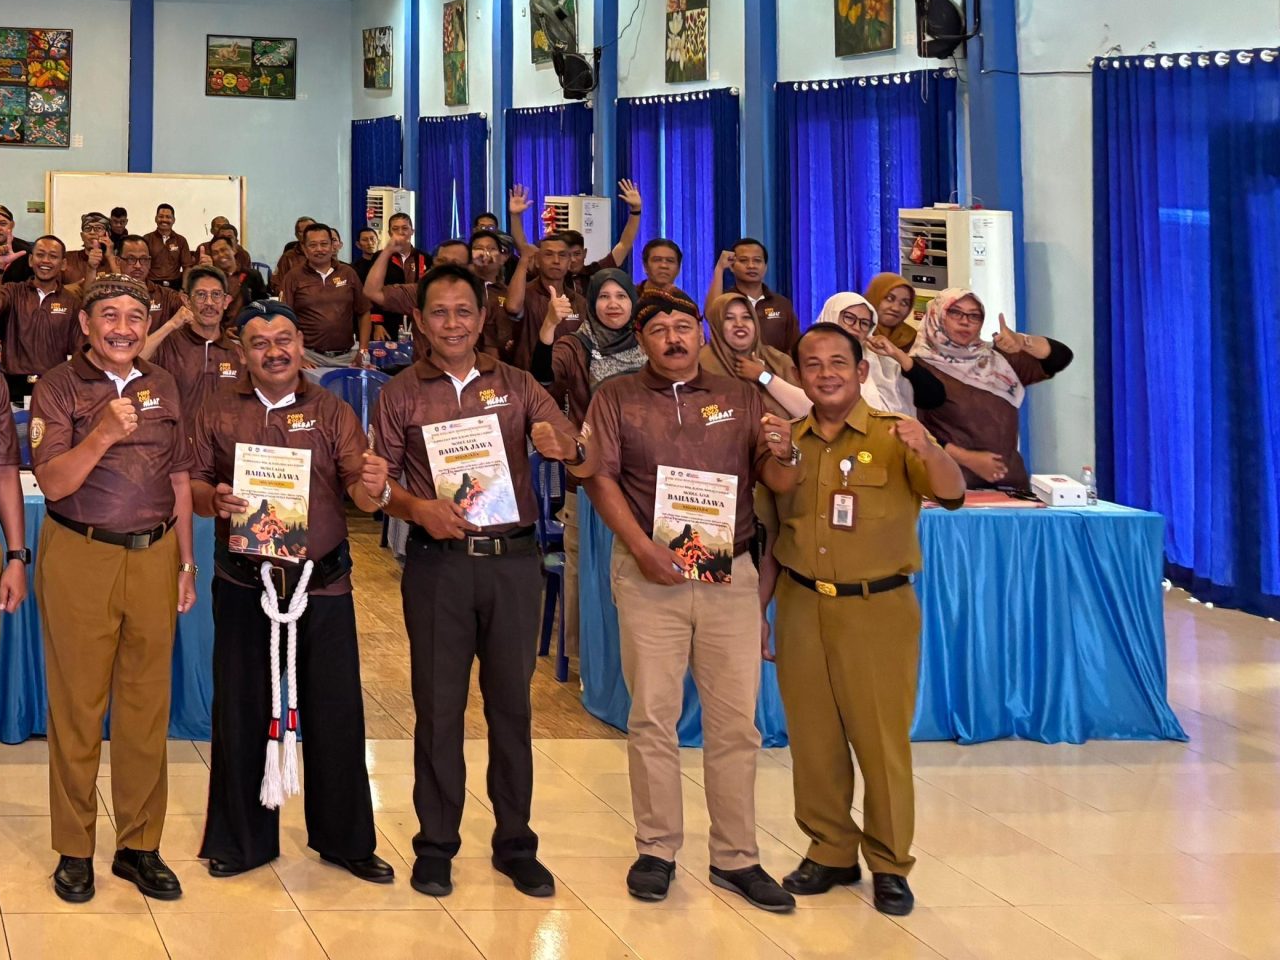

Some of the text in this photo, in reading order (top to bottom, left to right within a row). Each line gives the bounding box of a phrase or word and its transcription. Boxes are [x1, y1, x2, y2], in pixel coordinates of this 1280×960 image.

[708, 409, 734, 422] HEBAT
[292, 420, 317, 429] HEBAT
[439, 445, 469, 456] BAHASA
[470, 441, 493, 450] JAWA
[245, 470, 299, 481] BAHASA JAWA
[667, 493, 725, 508] BAHASA JAWA
